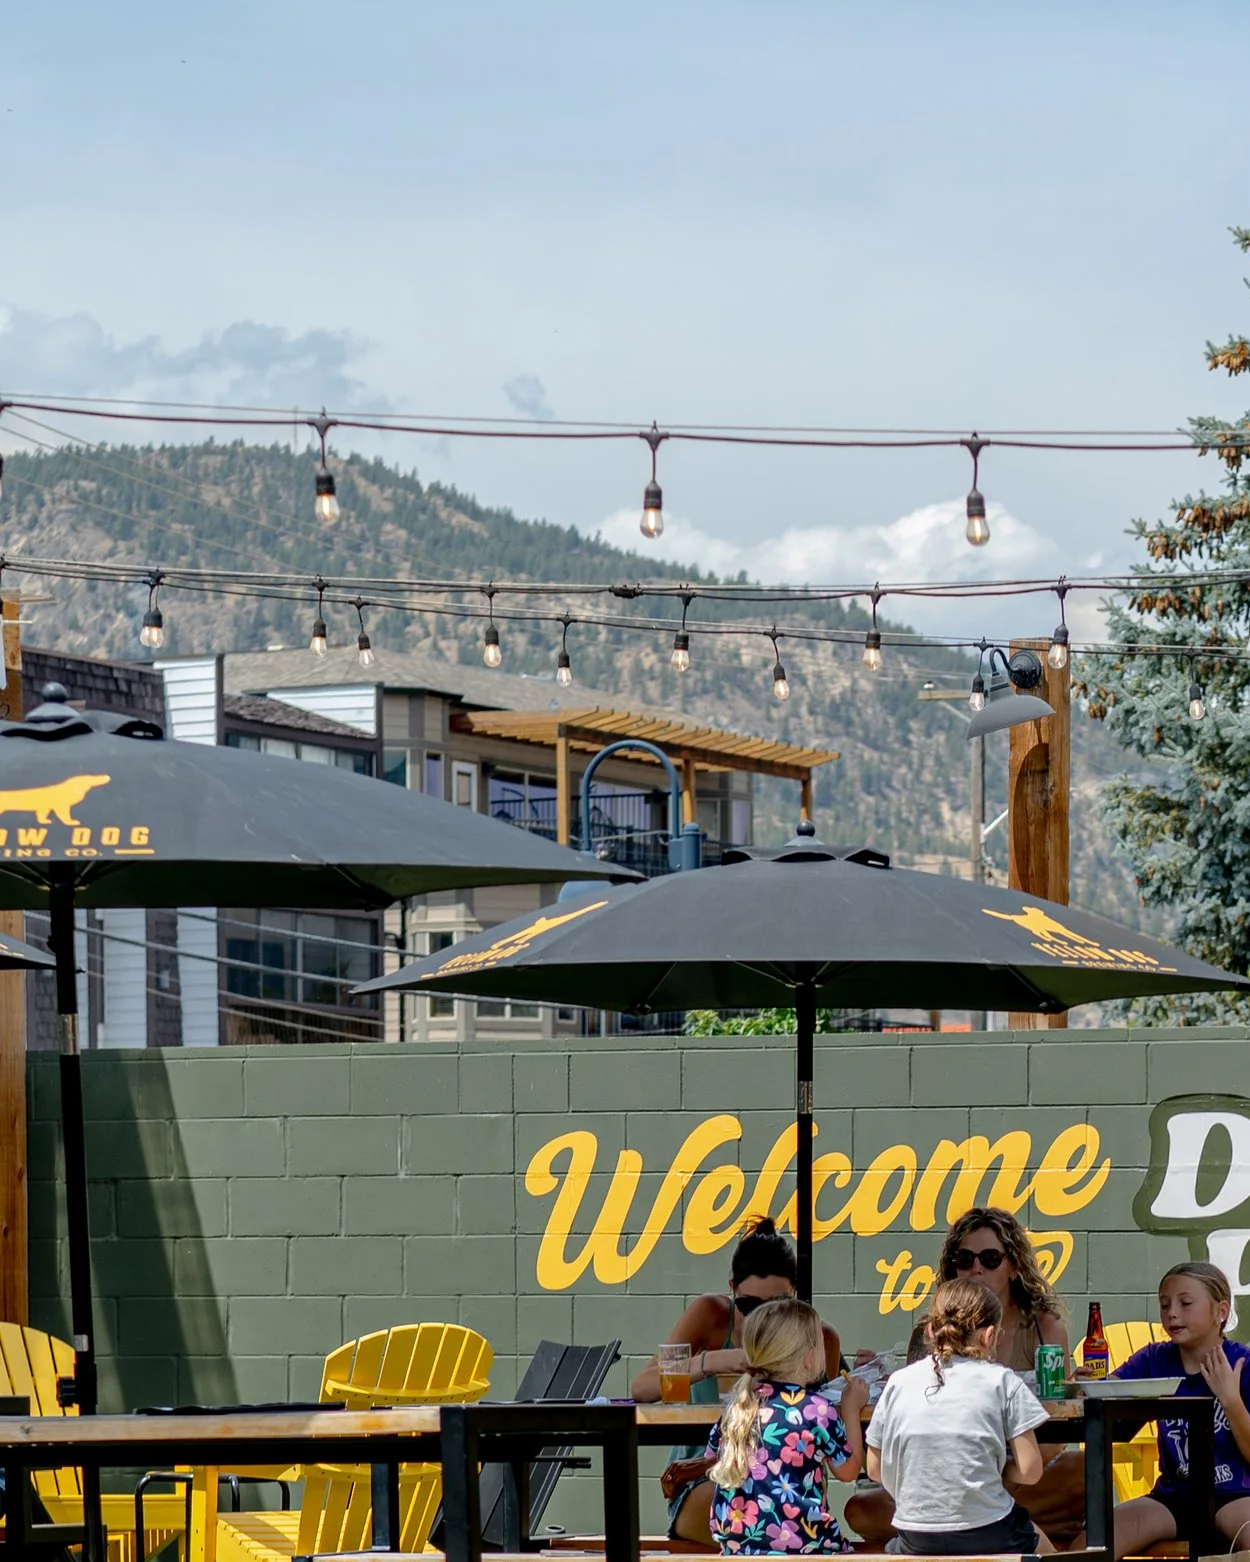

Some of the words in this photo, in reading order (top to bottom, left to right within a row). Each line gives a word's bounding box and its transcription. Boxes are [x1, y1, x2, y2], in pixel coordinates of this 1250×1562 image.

[71, 826, 150, 846] DOG
[525, 1114, 1111, 1291] Welcome
[875, 1250, 938, 1315] to
